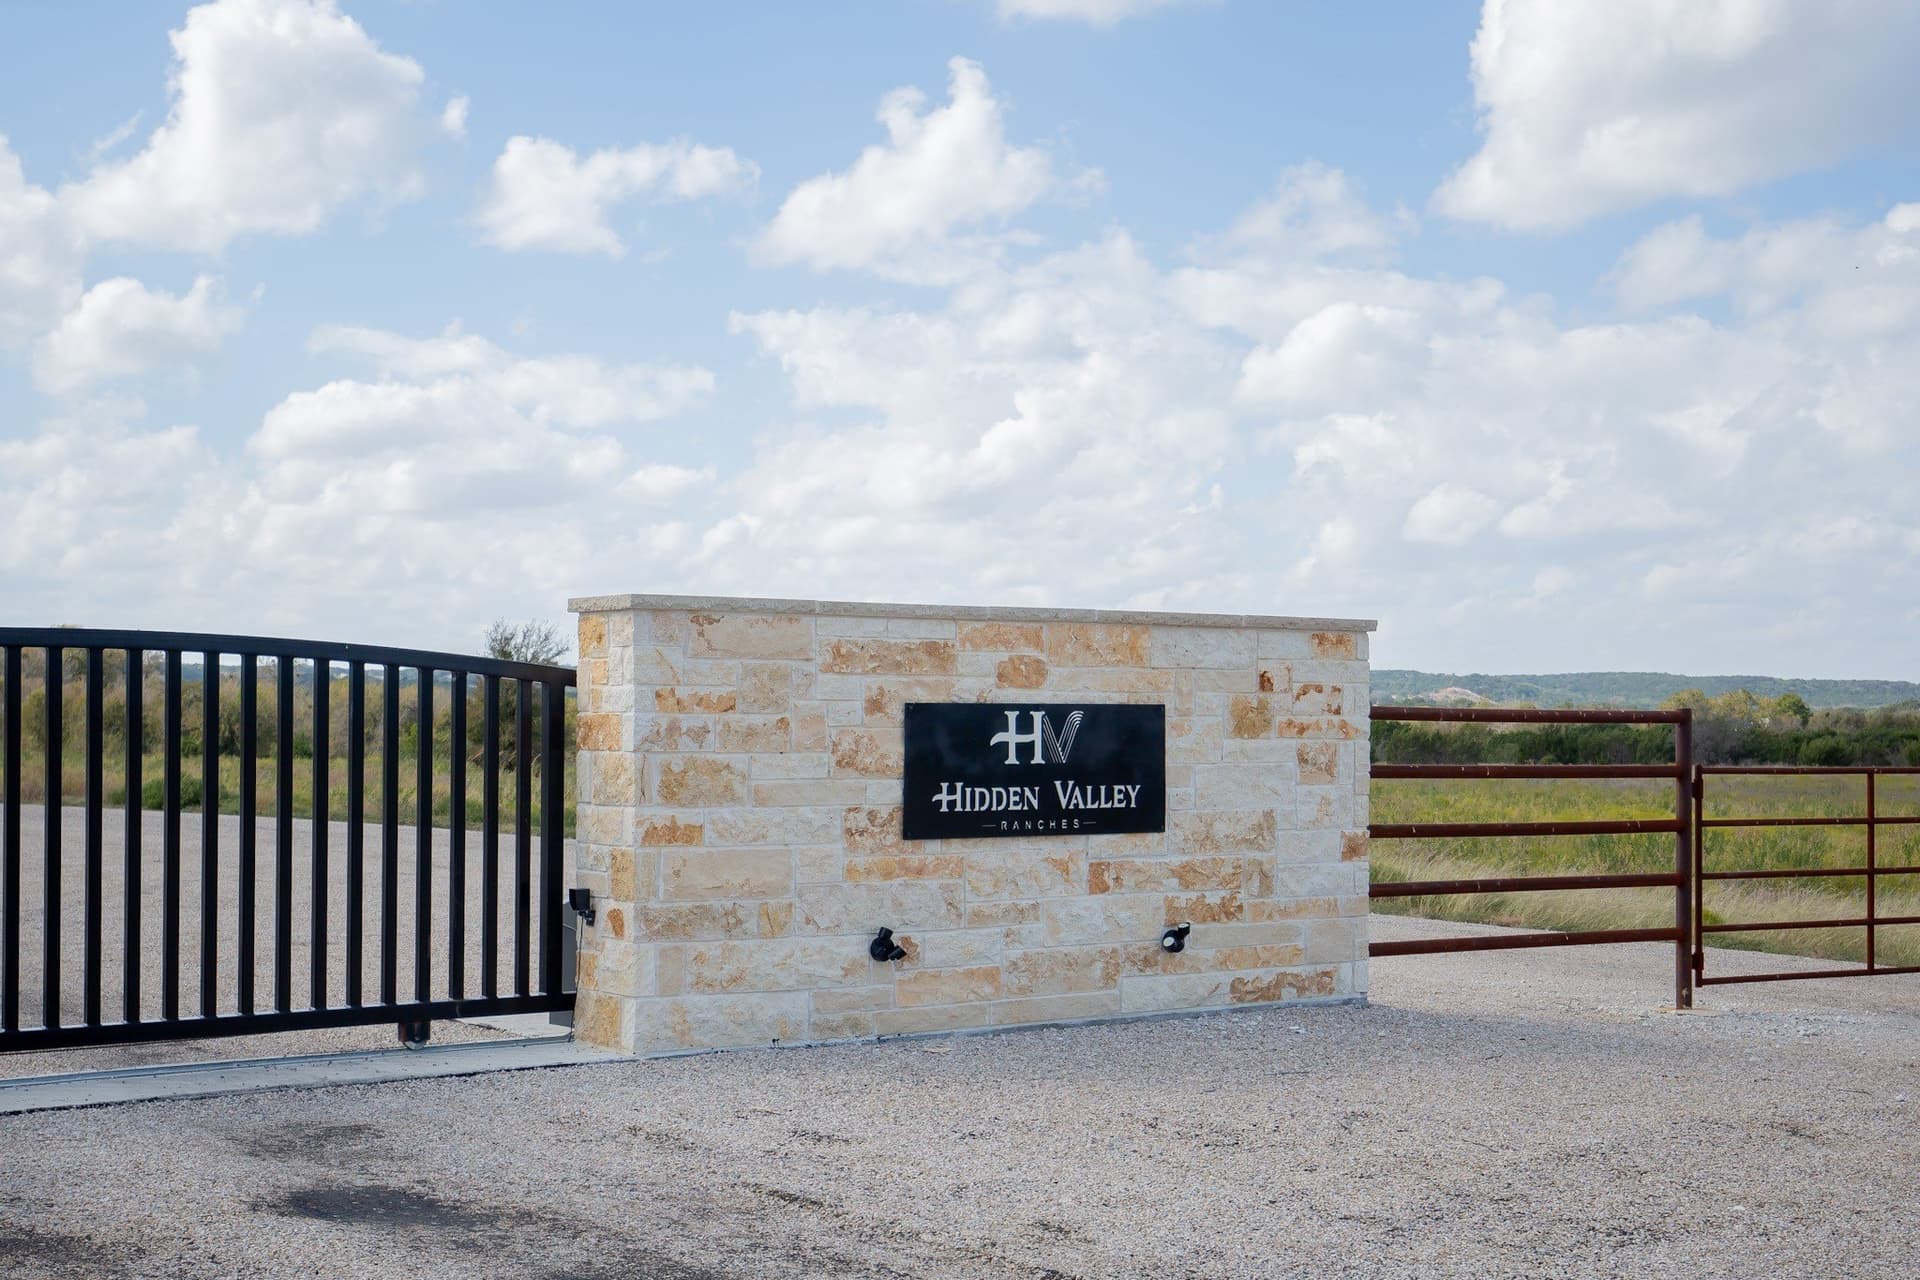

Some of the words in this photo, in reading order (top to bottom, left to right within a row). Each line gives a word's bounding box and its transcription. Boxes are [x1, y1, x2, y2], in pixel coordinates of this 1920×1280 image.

[990, 710, 1084, 764] HV
[932, 782, 1040, 812] HIDDEN
[1054, 780, 1141, 809] VALLEY
[1001, 818, 1080, 830] RANCHES
